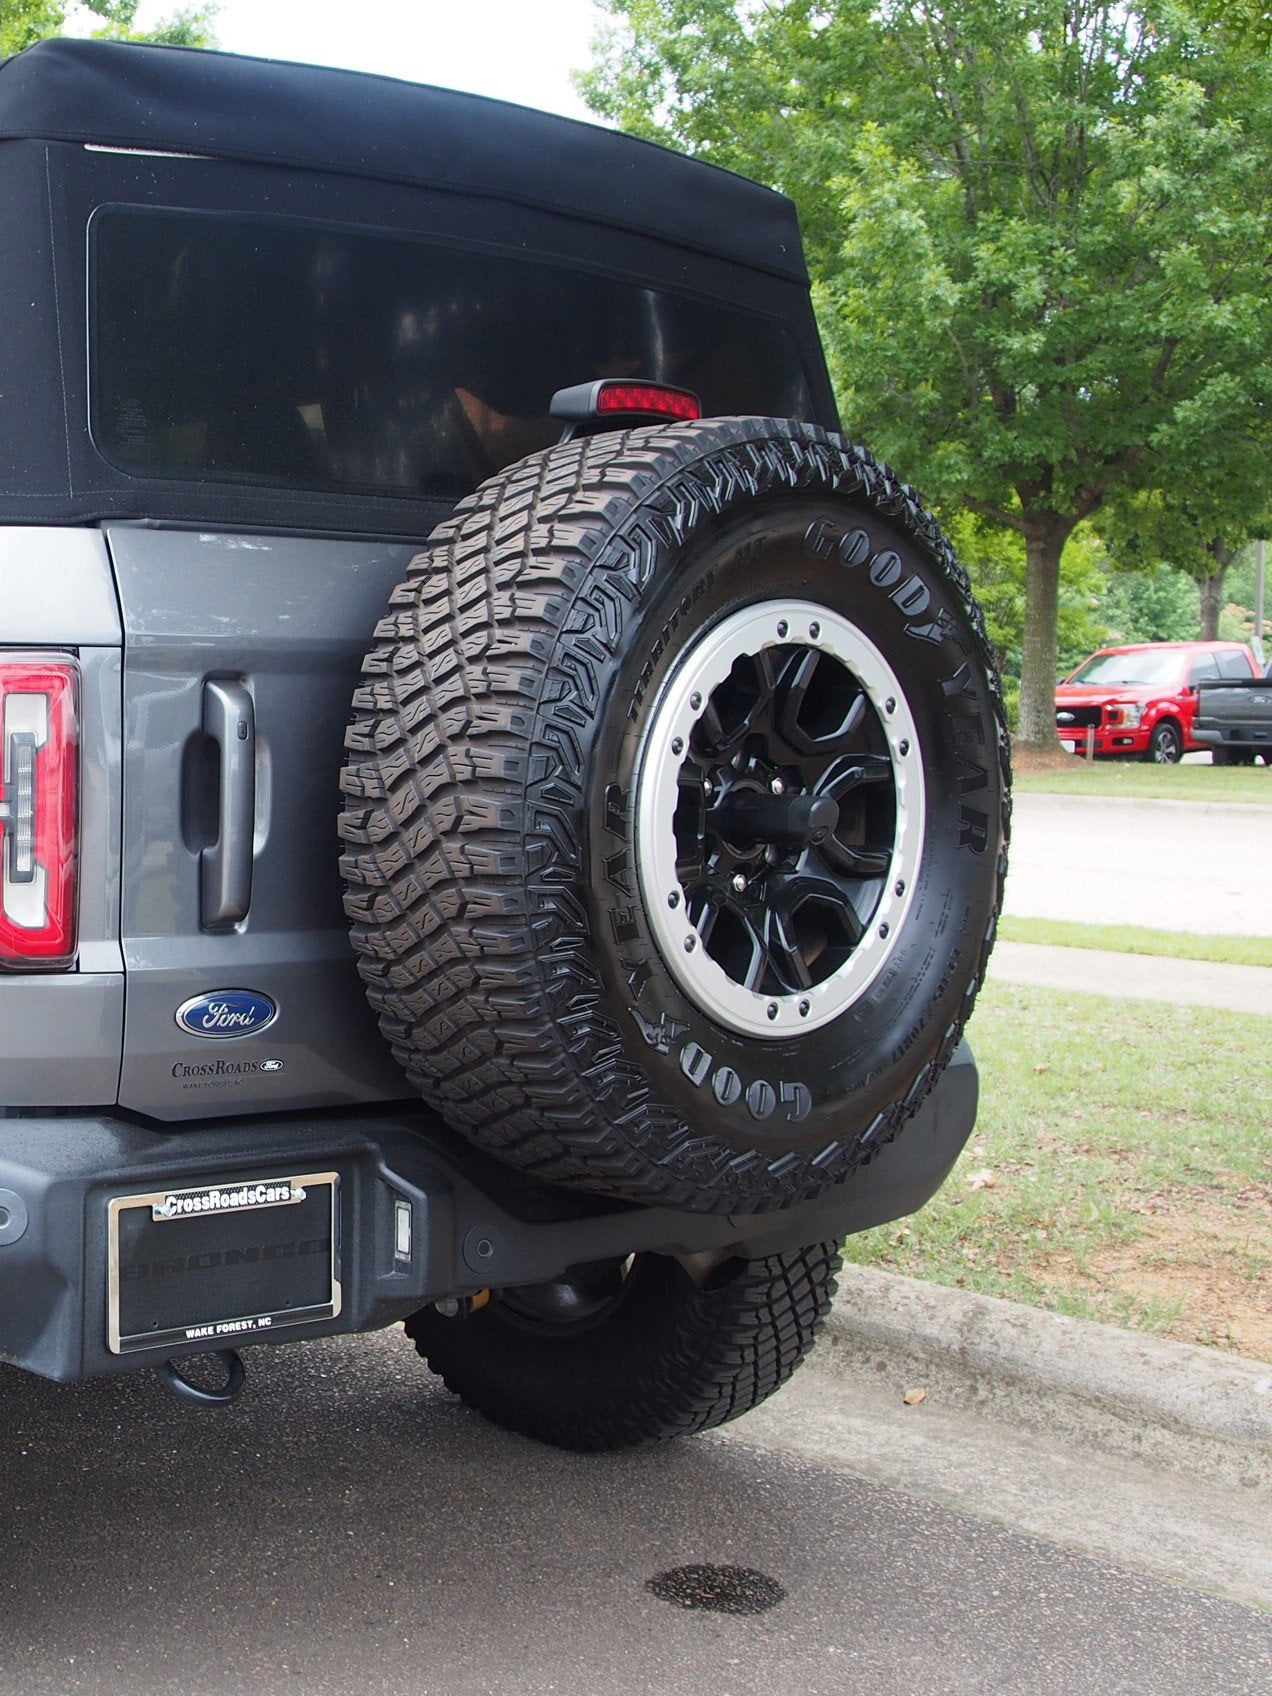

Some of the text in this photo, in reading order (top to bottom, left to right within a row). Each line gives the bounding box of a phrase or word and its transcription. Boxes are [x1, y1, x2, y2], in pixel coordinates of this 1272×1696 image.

[803, 515, 990, 855] GOODYEAR
[602, 782, 812, 1123] GOODYEAR
[202, 1002, 254, 1028] Ford
[165, 1185, 290, 1215] CrossRoadsCars
[186, 1317, 272, 1339] WAKE FOREST, NC
